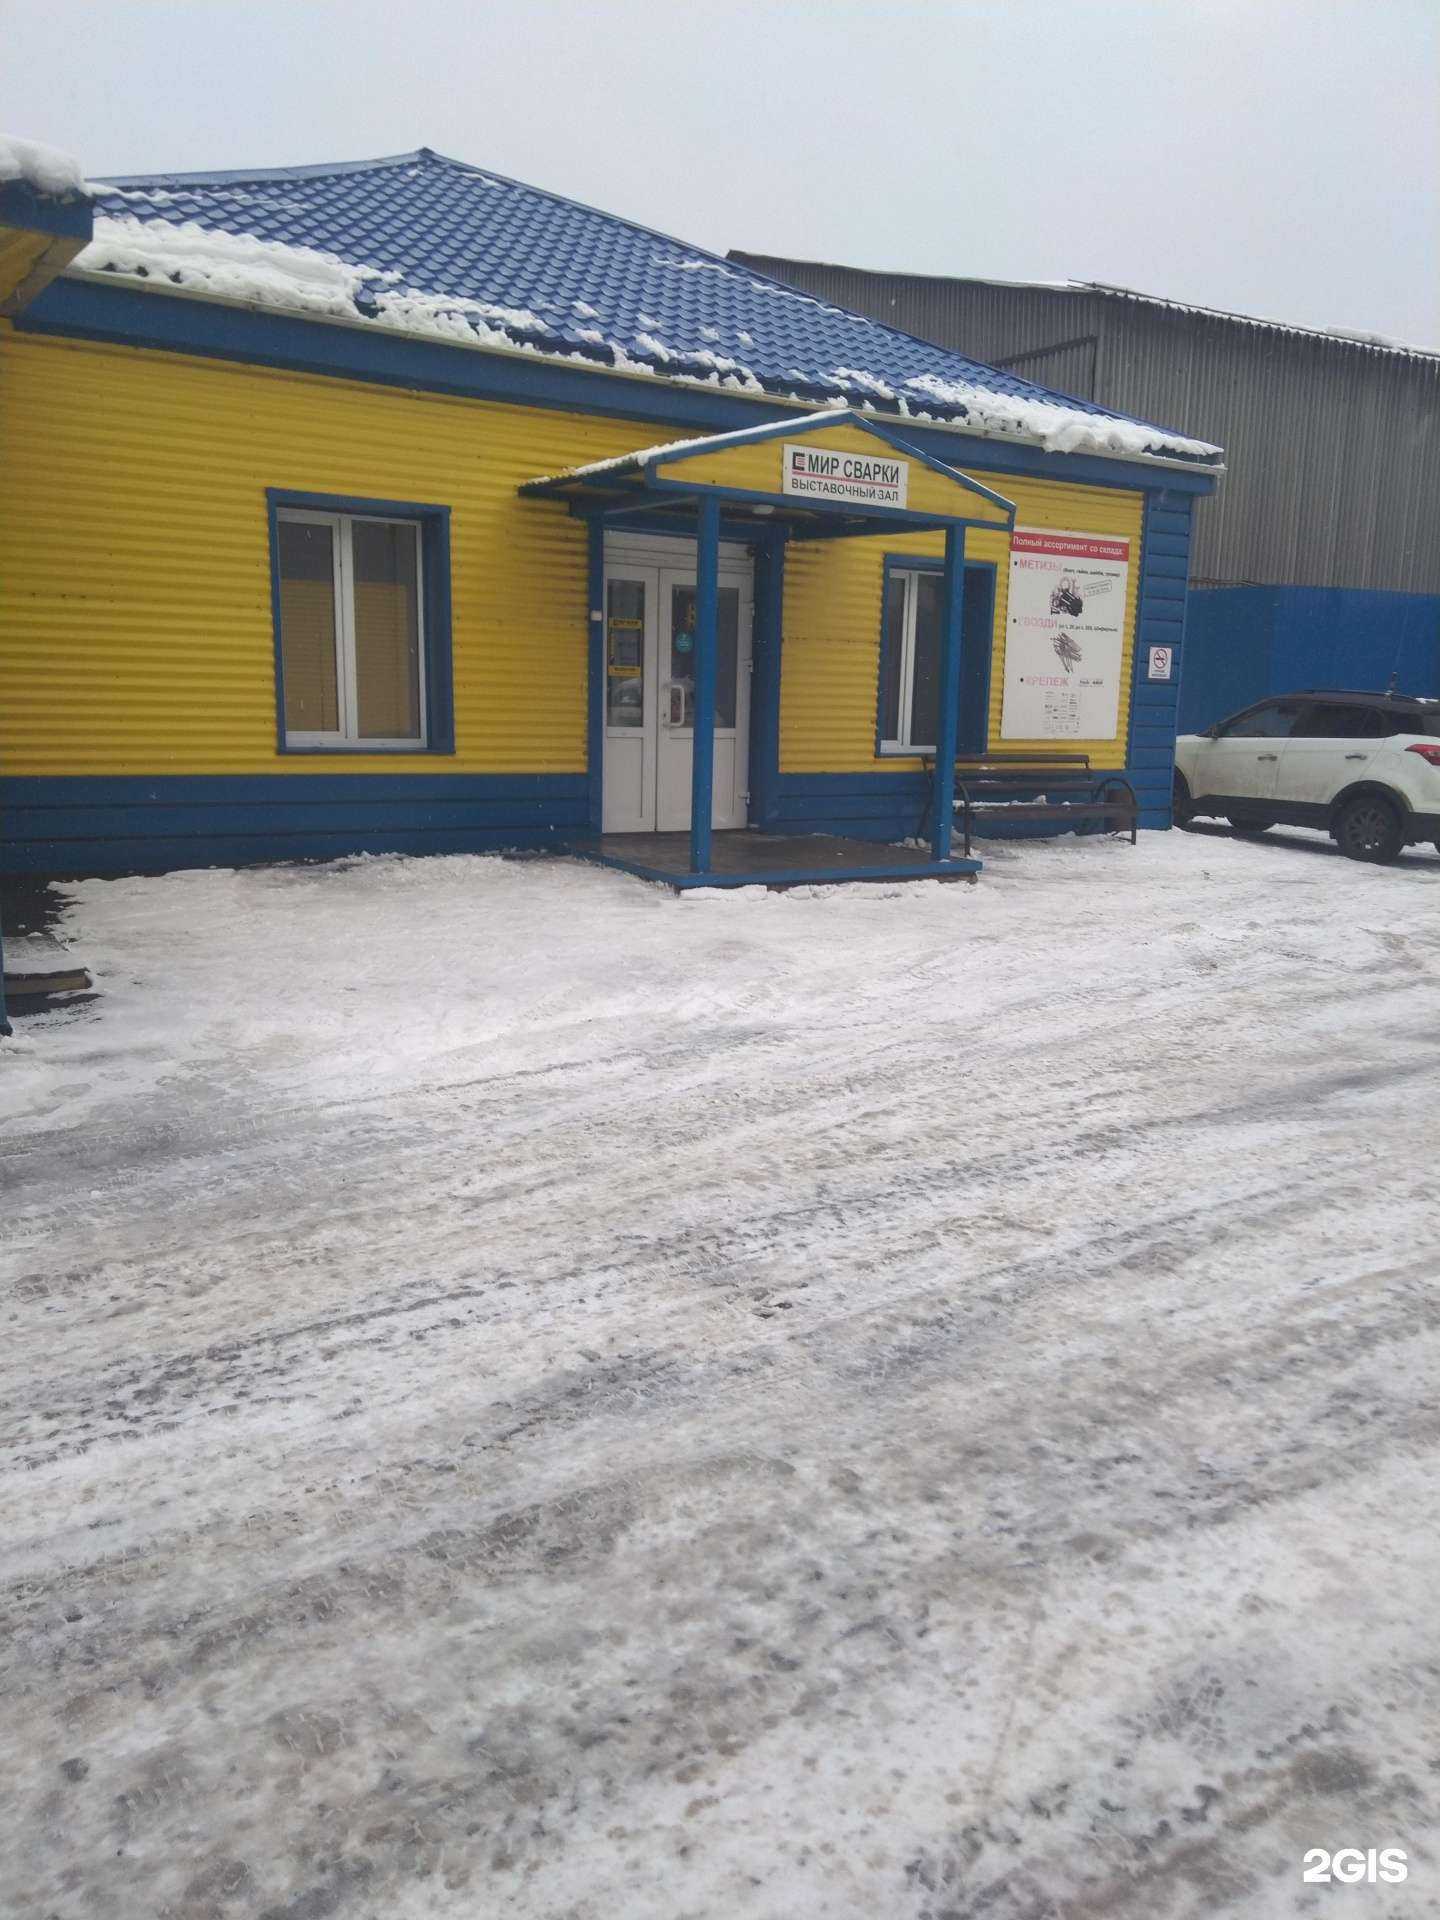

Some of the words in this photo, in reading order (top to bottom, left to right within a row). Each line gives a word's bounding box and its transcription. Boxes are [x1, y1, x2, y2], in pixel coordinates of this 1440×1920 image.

[808, 454, 839, 475] МИР
[843, 460, 899, 483] СВАРКИ
[791, 478, 876, 499] ВЫСТАВОЧНЫЙ
[878, 489, 899, 501] ЗАЛ
[1013, 535, 1042, 547] Полный
[1043, 540, 1088, 553] ассортимент
